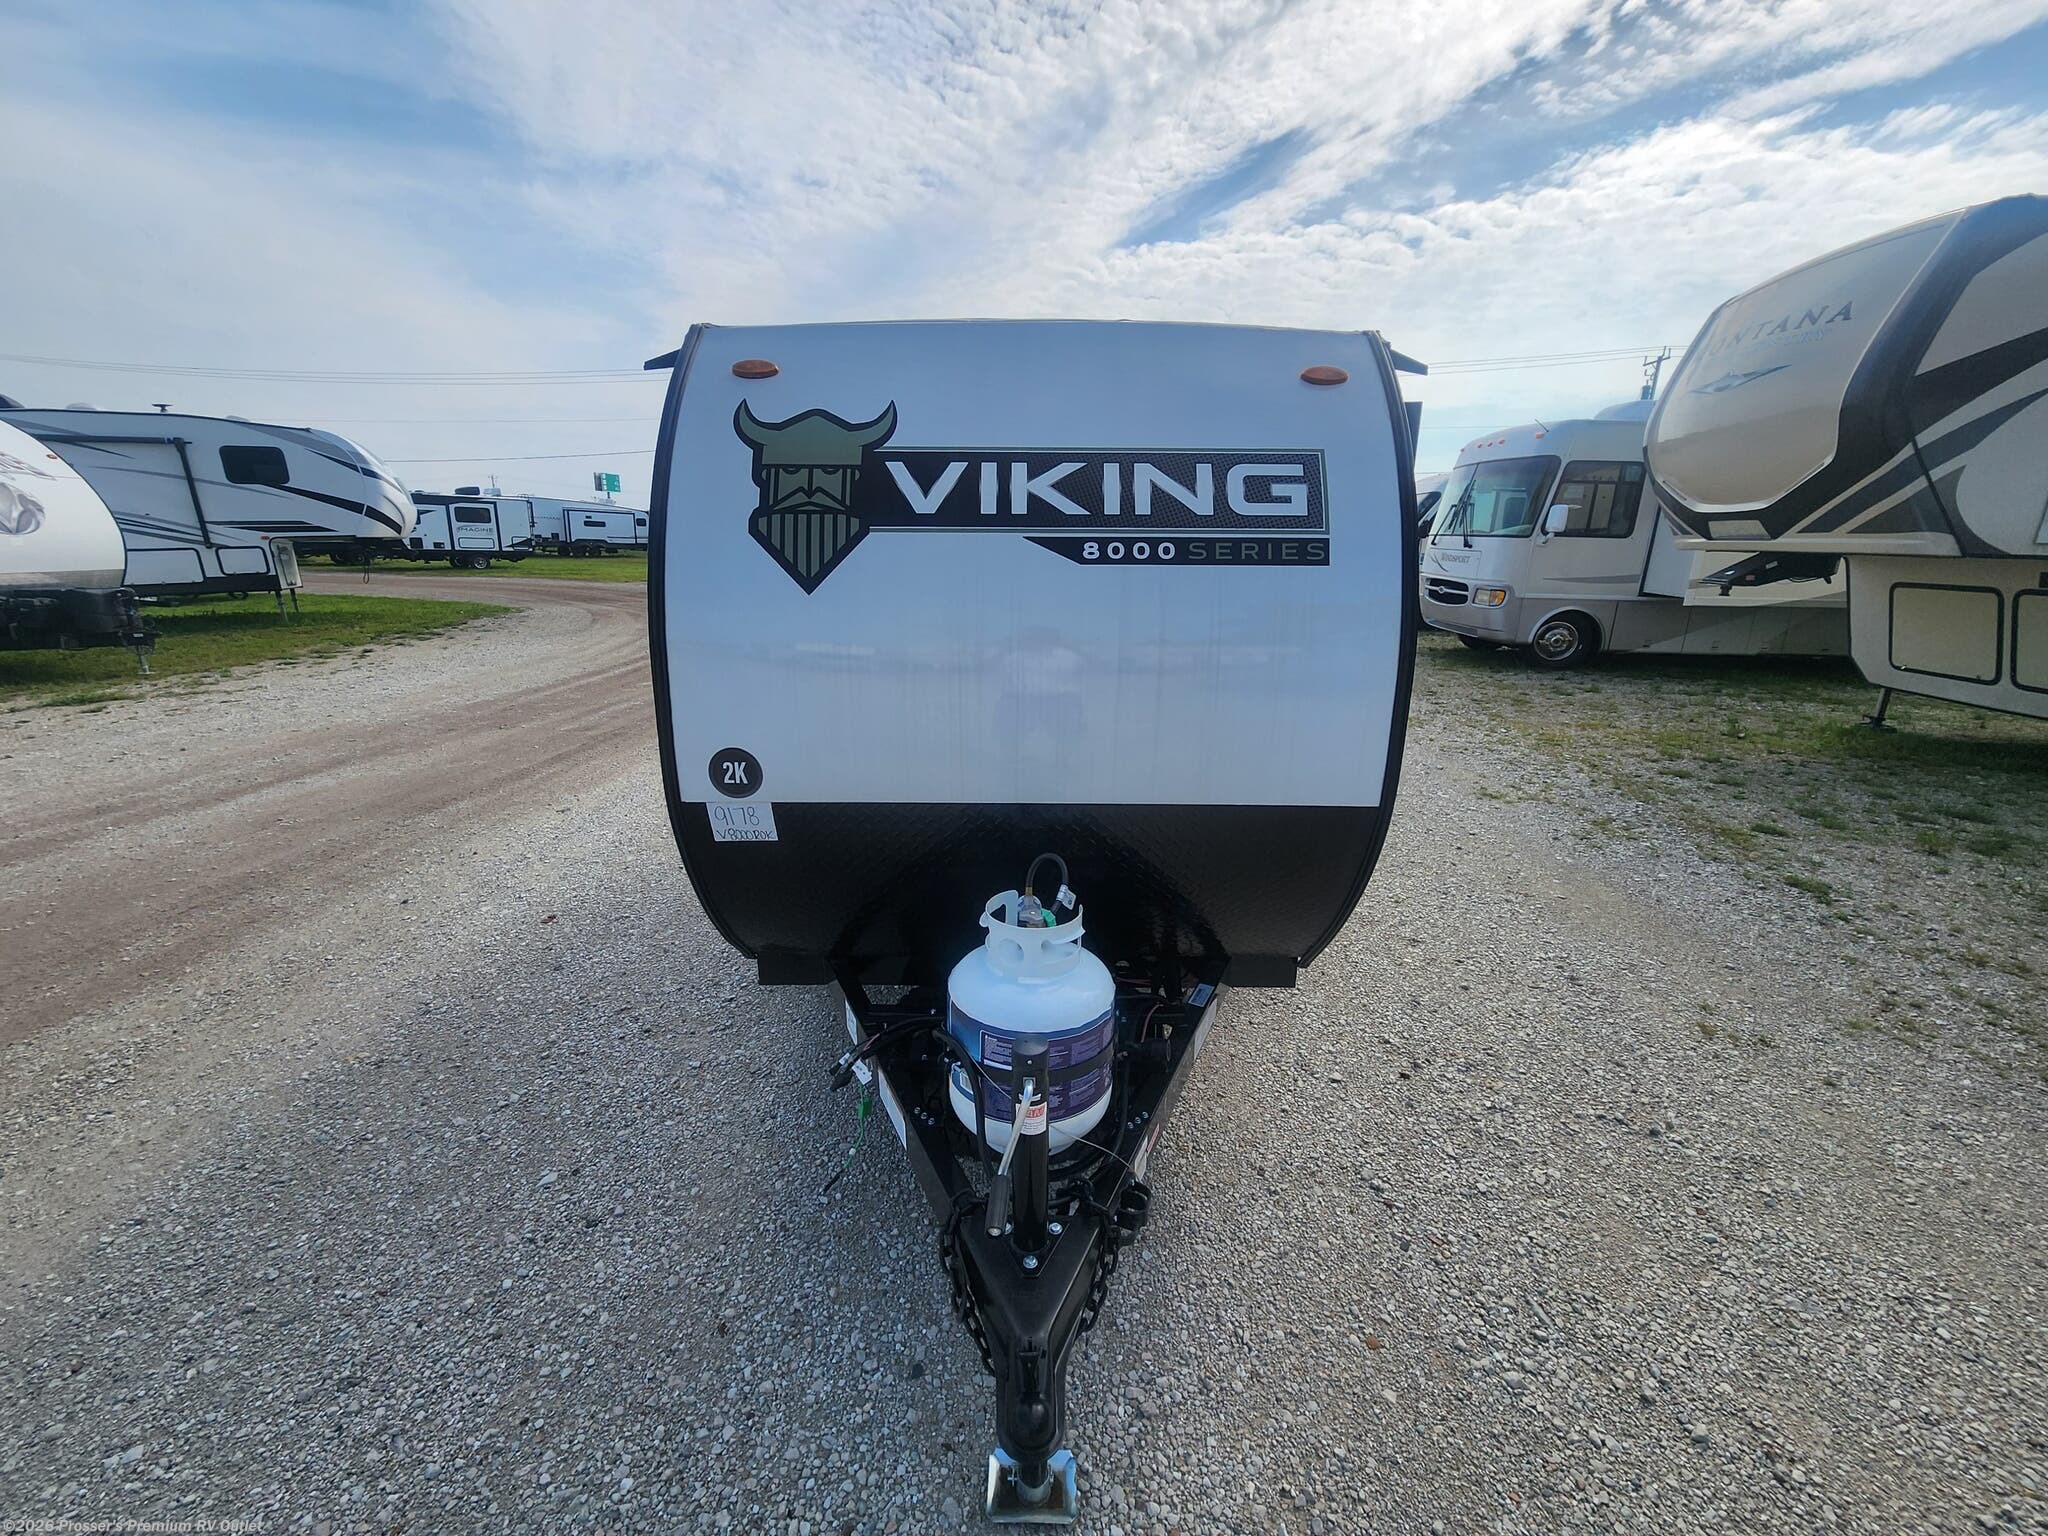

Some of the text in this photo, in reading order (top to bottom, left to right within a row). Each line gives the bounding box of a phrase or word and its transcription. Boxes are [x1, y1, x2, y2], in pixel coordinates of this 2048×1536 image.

[884, 461, 1309, 516] VIKING
[1082, 541, 1326, 560] 8000 SERIES
[722, 761, 749, 784] 2K
[714, 805, 760, 826] 9178
